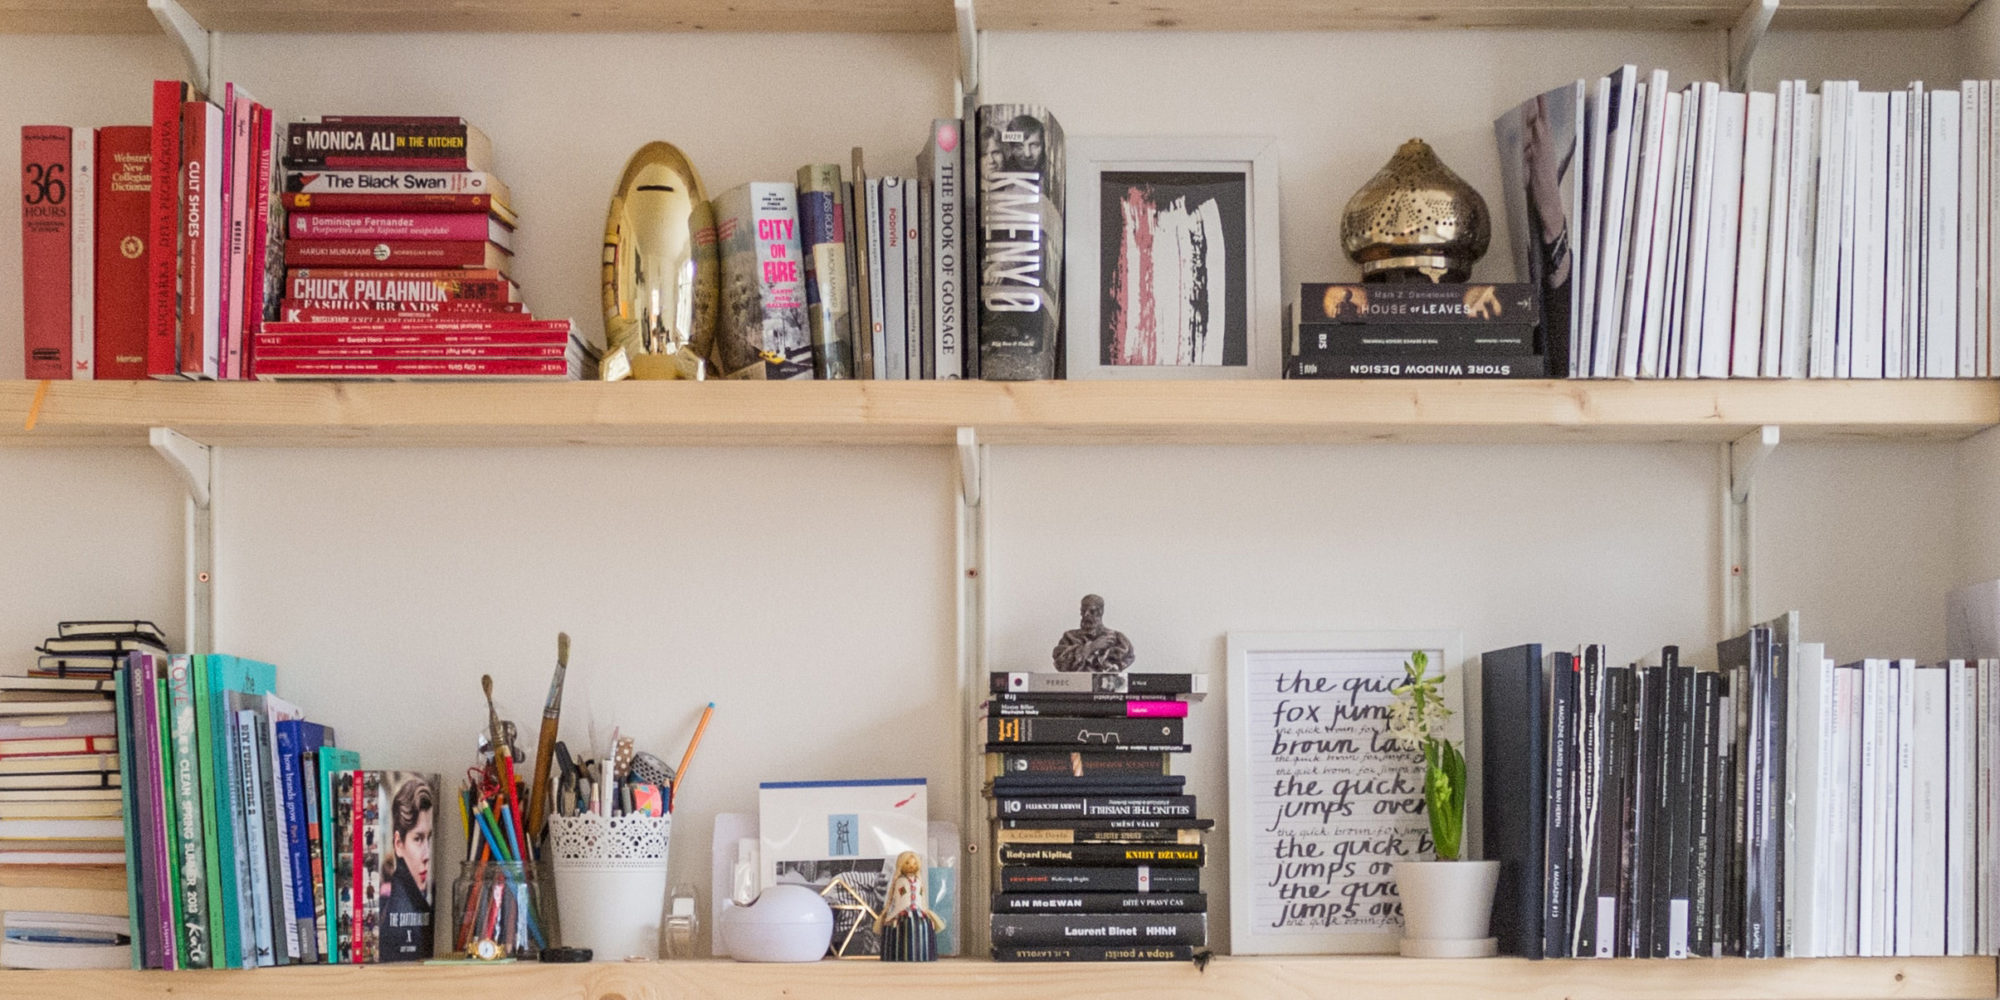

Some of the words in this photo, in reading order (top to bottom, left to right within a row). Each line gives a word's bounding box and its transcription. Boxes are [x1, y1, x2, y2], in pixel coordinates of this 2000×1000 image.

[306, 131, 364, 150] MONICA
[371, 131, 395, 151] ALI
[396, 137, 405, 147] IN
[409, 137, 424, 147] THE
[427, 137, 464, 148] KITCHEN
[123, 163, 144, 172] New
[189, 161, 200, 193] CULT
[25, 163, 66, 205] 36
[111, 172, 152, 184] Collegiat
[325, 175, 354, 188] The
[358, 175, 399, 189] Black
[404, 175, 447, 189] Swan
[941, 163, 954, 198] THE
[25, 207, 66, 217] HOURS
[188, 195, 200, 238] SHOES
[312, 217, 361, 227] Dominique
[365, 217, 414, 226] Fernandez
[758, 218, 794, 241] CITY
[942, 203, 954, 251] BOOK
[985, 171, 1041, 287] KMENY
[300, 249, 329, 257] HARUKI
[331, 249, 371, 257] MURAKAMI
[770, 244, 786, 258] ON
[763, 261, 798, 283] FIRE
[942, 255, 954, 277] OF
[294, 279, 349, 300] CHUCK
[354, 280, 448, 302] PALAHNIUK
[304, 300, 369, 311] FASHION
[376, 300, 439, 313] BRANDS
[1362, 304, 1406, 314] HOUSE
[1422, 304, 1471, 314] LEAVES
[942, 280, 955, 354] GOSSAGE
[1350, 364, 1400, 376] DESIGN
[1405, 364, 1463, 375] WINDOW
[1467, 364, 1511, 376] STORE
[171, 656, 189, 707] LOVE
[1275, 669, 1337, 694] the
[1273, 699, 1321, 728] fox
[241, 724, 249, 744] DIY
[1295, 726, 1321, 736] quick
[284, 753, 294, 772] how
[1556, 767, 1563, 776] BY
[180, 760, 192, 796] CLEAN
[242, 745, 254, 804] FURNITURE
[286, 773, 295, 800] brands
[1274, 775, 1323, 797] the
[1332, 773, 1414, 811] quick
[181, 800, 194, 839] SPRING
[247, 807, 256, 815] 2
[285, 802, 297, 822] grow
[1089, 806, 1131, 814] INVISIBLE
[1133, 806, 1151, 814] THE
[1153, 806, 1190, 815] SELLING
[1265, 800, 1355, 832] jumps
[1042, 850, 1073, 860] Kipling
[1125, 850, 1155, 859] KNIHY
[1274, 836, 1324, 860] the
[1332, 834, 1410, 870] quick
[184, 843, 196, 885] SUMMER
[1268, 860, 1355, 887] jumps
[1279, 882, 1331, 900] the
[186, 891, 198, 914] 2013
[1146, 898, 1169, 906] PRAVÝ
[1272, 900, 1361, 928] jumps
[1065, 926, 1107, 936] Laurent
[1108, 926, 1137, 936] Binet
[1146, 926, 1176, 935] HHhH
[1146, 949, 1174, 957] stopa
